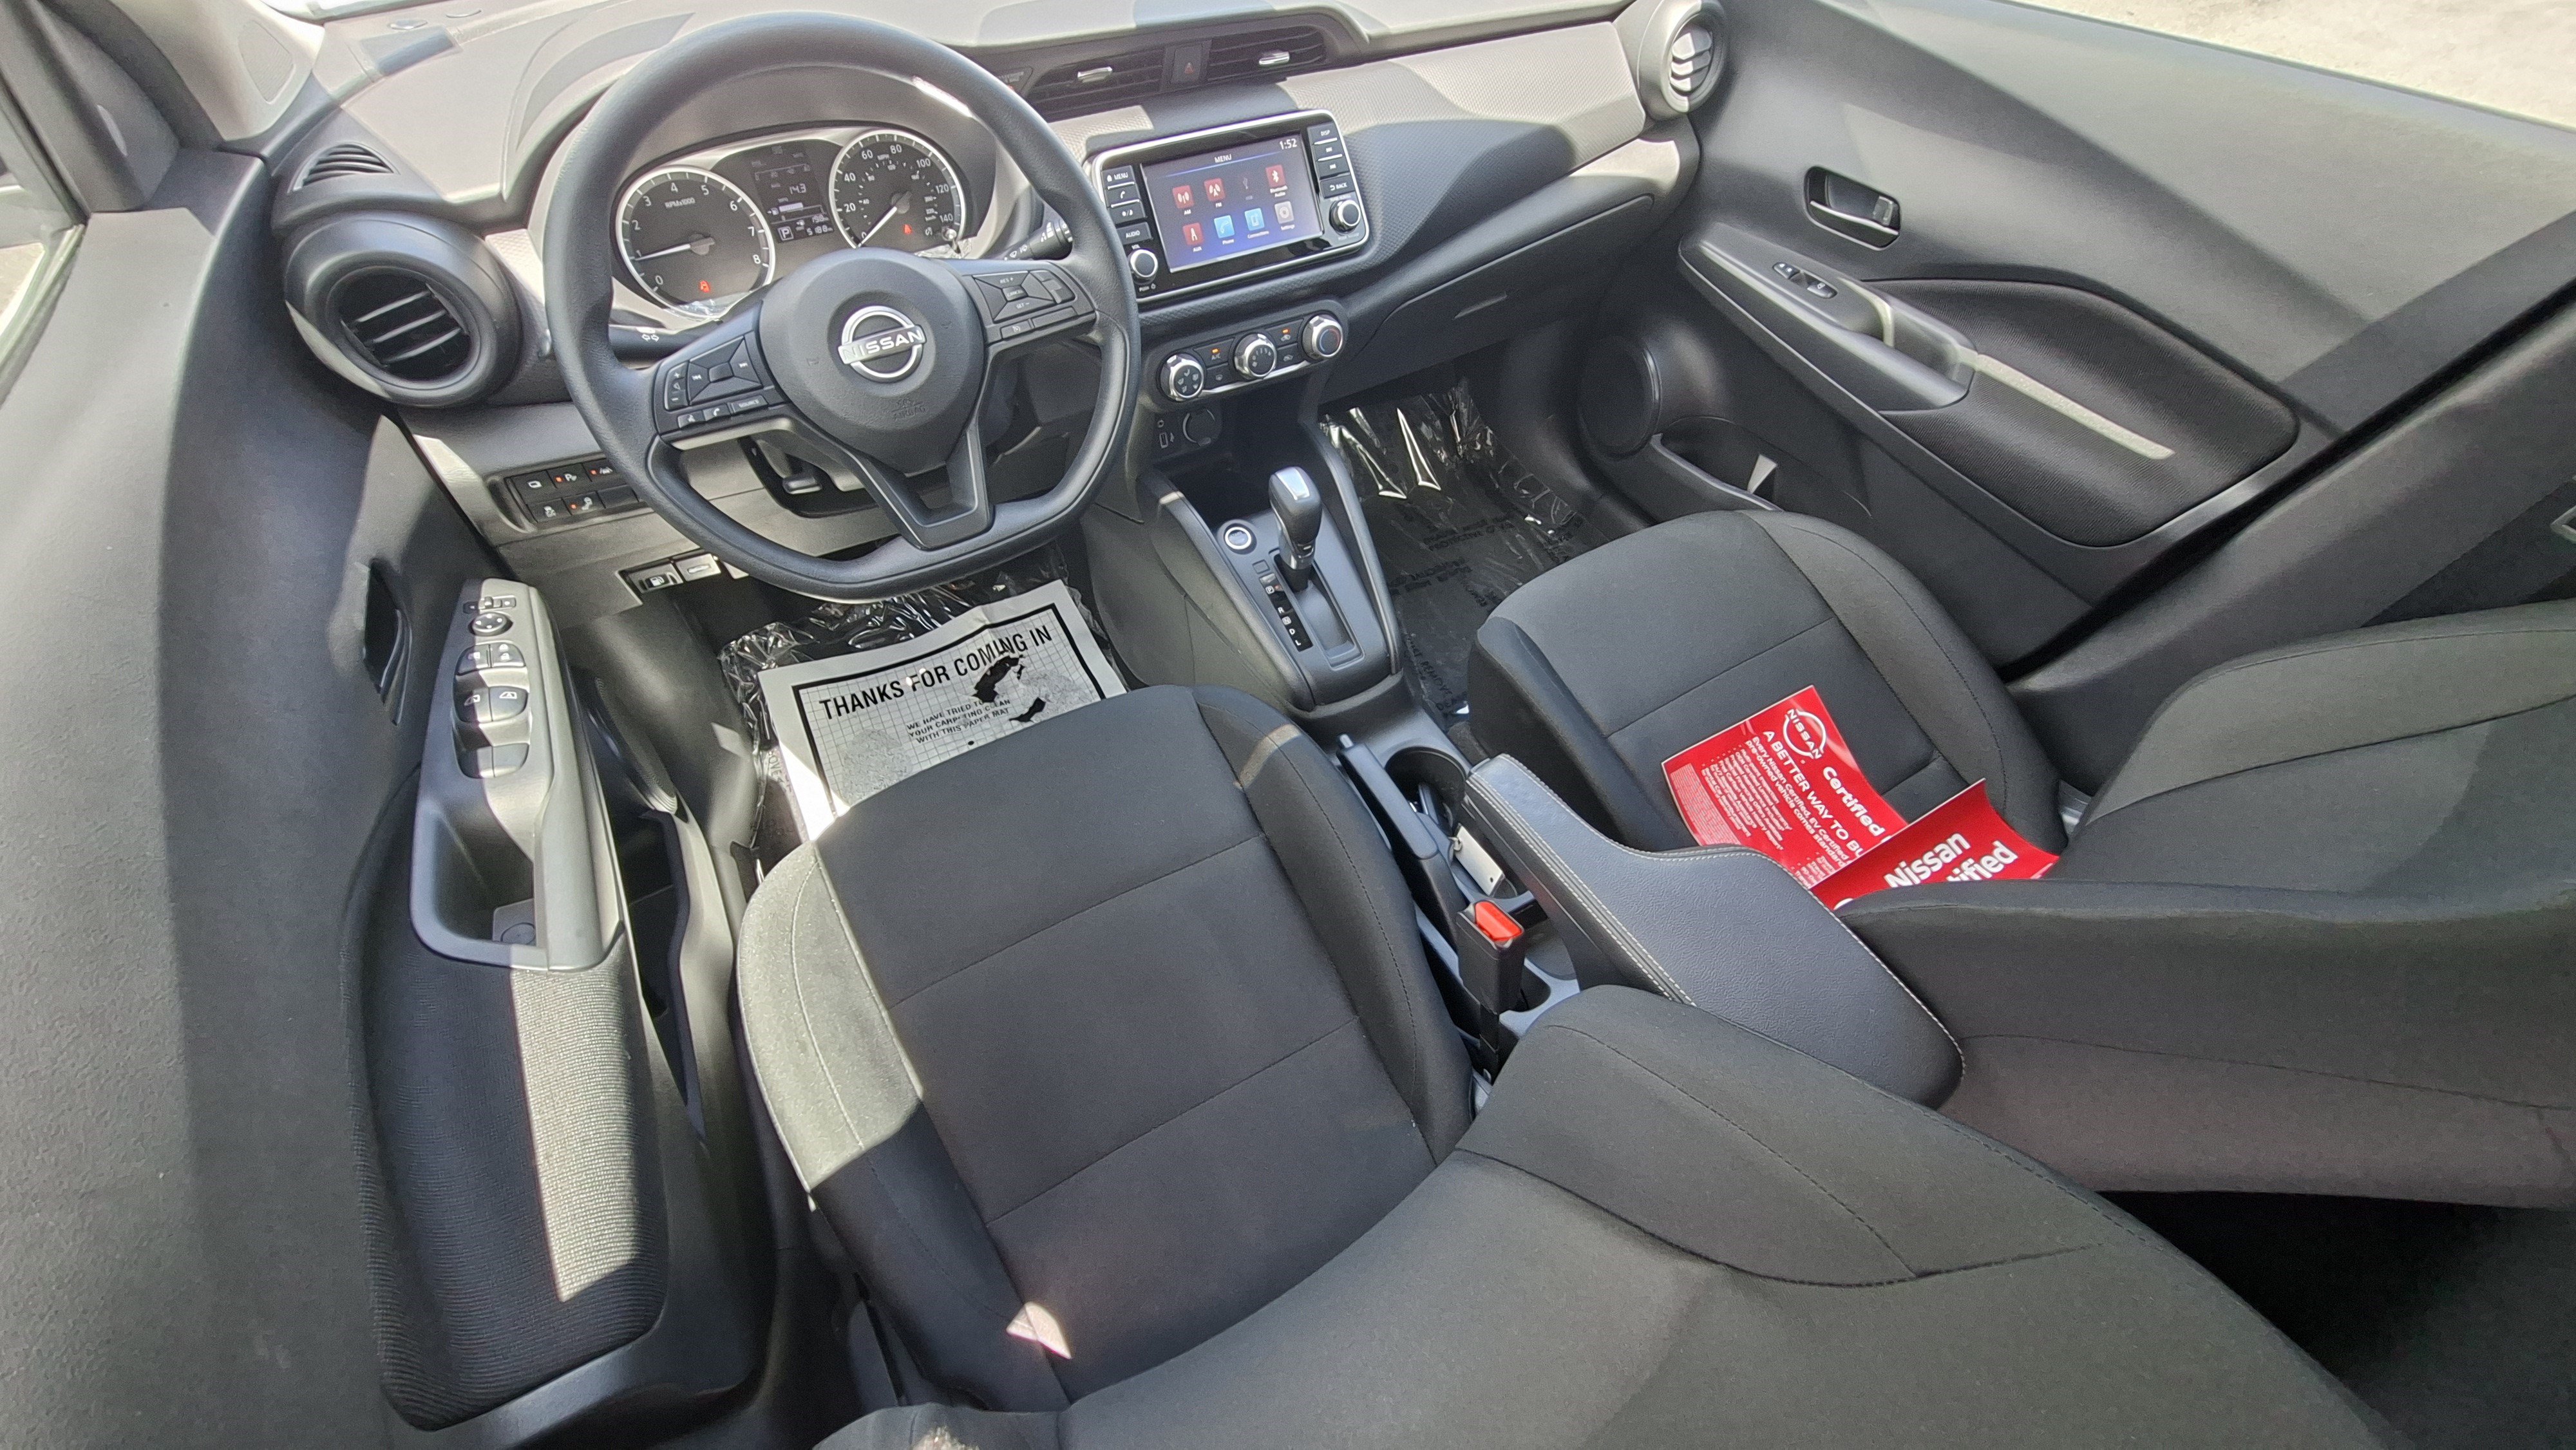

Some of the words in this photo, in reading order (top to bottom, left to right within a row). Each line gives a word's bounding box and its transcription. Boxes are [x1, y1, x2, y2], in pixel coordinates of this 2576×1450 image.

[890, 144, 902, 154] 80
[1280, 138, 1298, 150] 1:52
[862, 149, 873, 160] 60
[1214, 154, 1232, 163] MENU
[916, 158, 931, 168] 100
[844, 173, 856, 182] 40
[1113, 172, 1128, 180] MENU
[670, 183, 678, 193] 4
[701, 185, 709, 195] 5
[936, 184, 949, 194] 120
[643, 196, 651, 206] 3
[730, 201, 737, 211] 6
[844, 203, 856, 213] 20
[940, 213, 954, 223] 140
[632, 220, 640, 230] 2
[748, 226, 755, 236] 7
[1126, 230, 1141, 238] AUDIO
[753, 254, 761, 264] 8
[655, 276, 663, 285] 0
[842, 330, 923, 360] NISSAN
[819, 681, 904, 719] THANKS
[911, 665, 950, 692] FOR
[954, 634, 1028, 676] COMING
[1029, 625, 1052, 646] IN
[923, 712, 944, 725] HAVE
[947, 704, 971, 716] TRIED
[909, 726, 933, 737] YOUR
[936, 709, 983, 728] CARPTING
[916, 732, 940, 744] WITH
[942, 724, 961, 735] THIS
[992, 708, 1009, 718] MAT
[1786, 708, 1822, 759] NISSAN
[1745, 739, 1778, 782] pre-owned
[1774, 780, 1796, 809] vehicle
[1792, 808, 1815, 834] comes
[1762, 731, 1774, 742] A
[1770, 740, 1811, 792] BETTER
[1806, 790, 1833, 818] WAY
[1830, 819, 1846, 839] TO
[1752, 736, 1769, 757] Every
[1766, 757, 1787, 784] Nissan
[1785, 782, 1810, 818] Certified,
[1808, 817, 1821, 827] EV
[1819, 827, 1850, 860] Certified
[1824, 767, 1886, 836] Certified
[1884, 833, 1971, 888] Nissan
